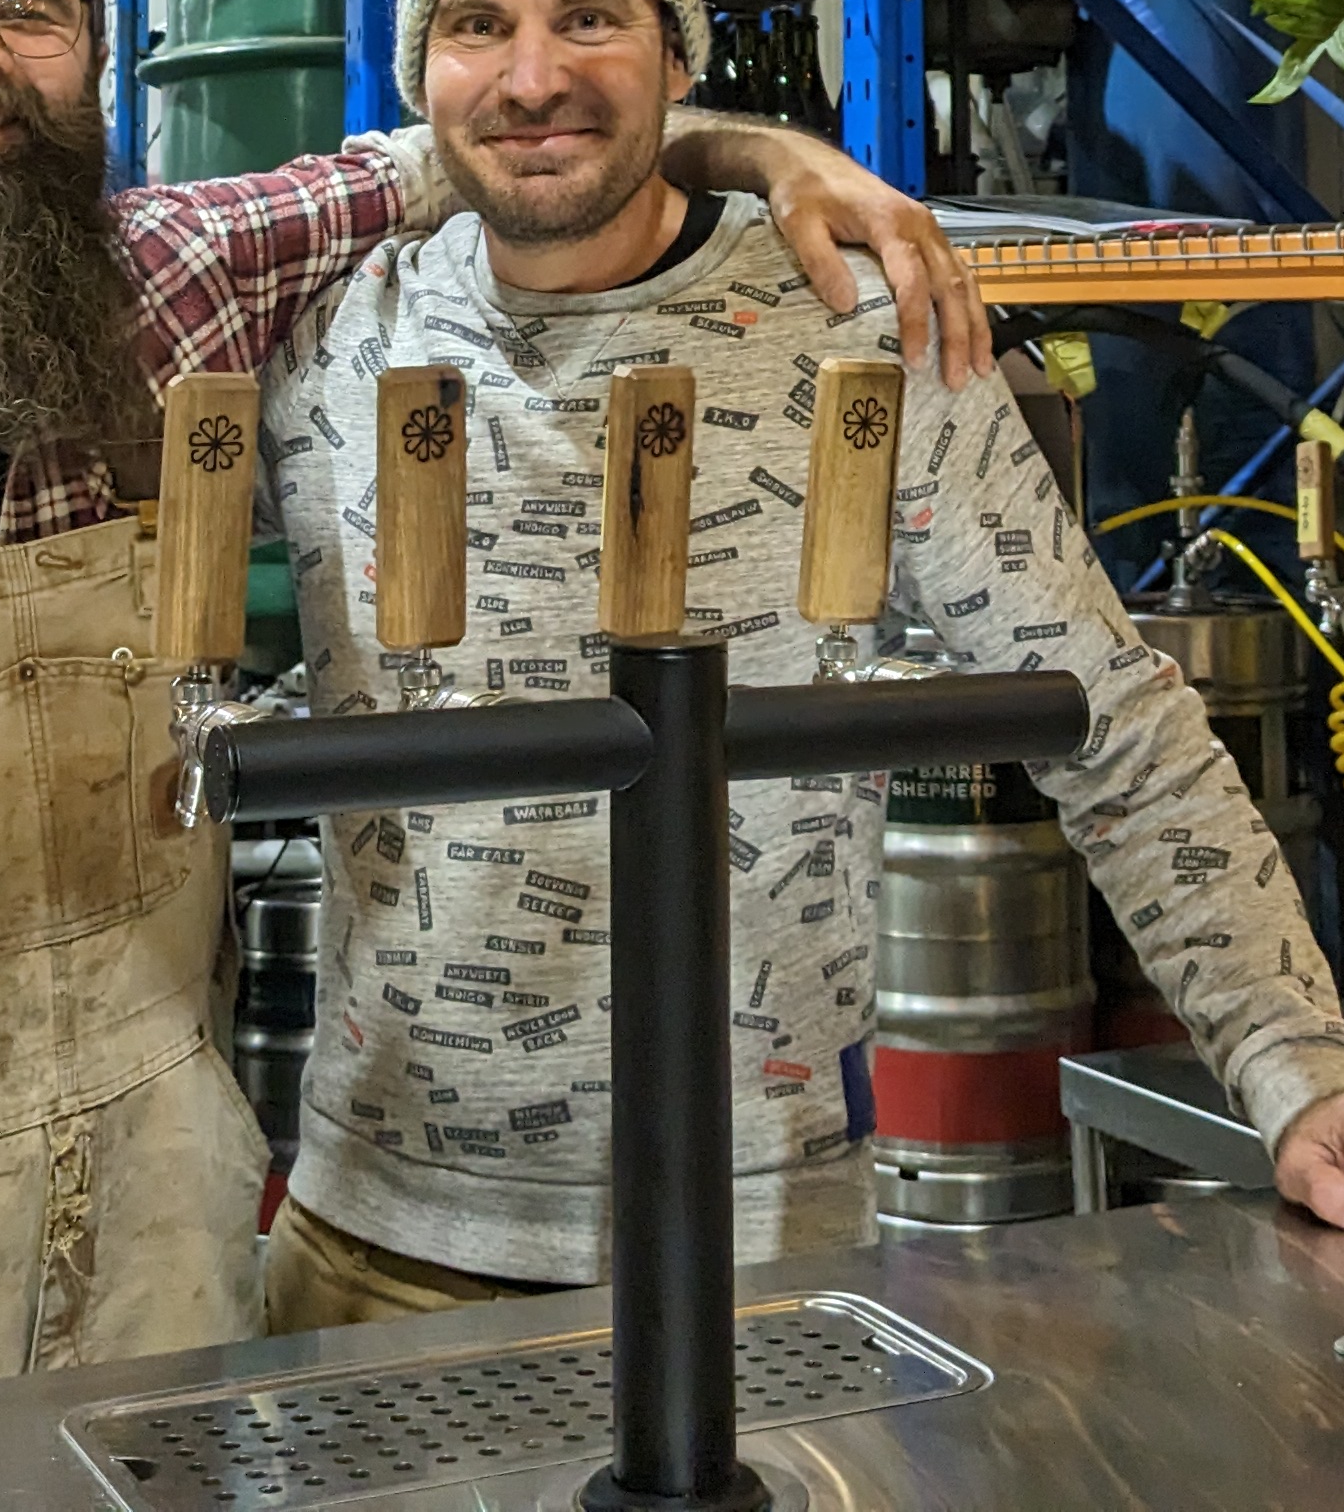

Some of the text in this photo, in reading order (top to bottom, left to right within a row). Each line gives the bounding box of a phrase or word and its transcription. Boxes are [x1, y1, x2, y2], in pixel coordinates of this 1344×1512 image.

[527, 399, 553, 410] FAR
[918, 764, 995, 780] BARREL
[890, 780, 997, 799] SHEPHERD
[450, 845, 475, 859] FAR
